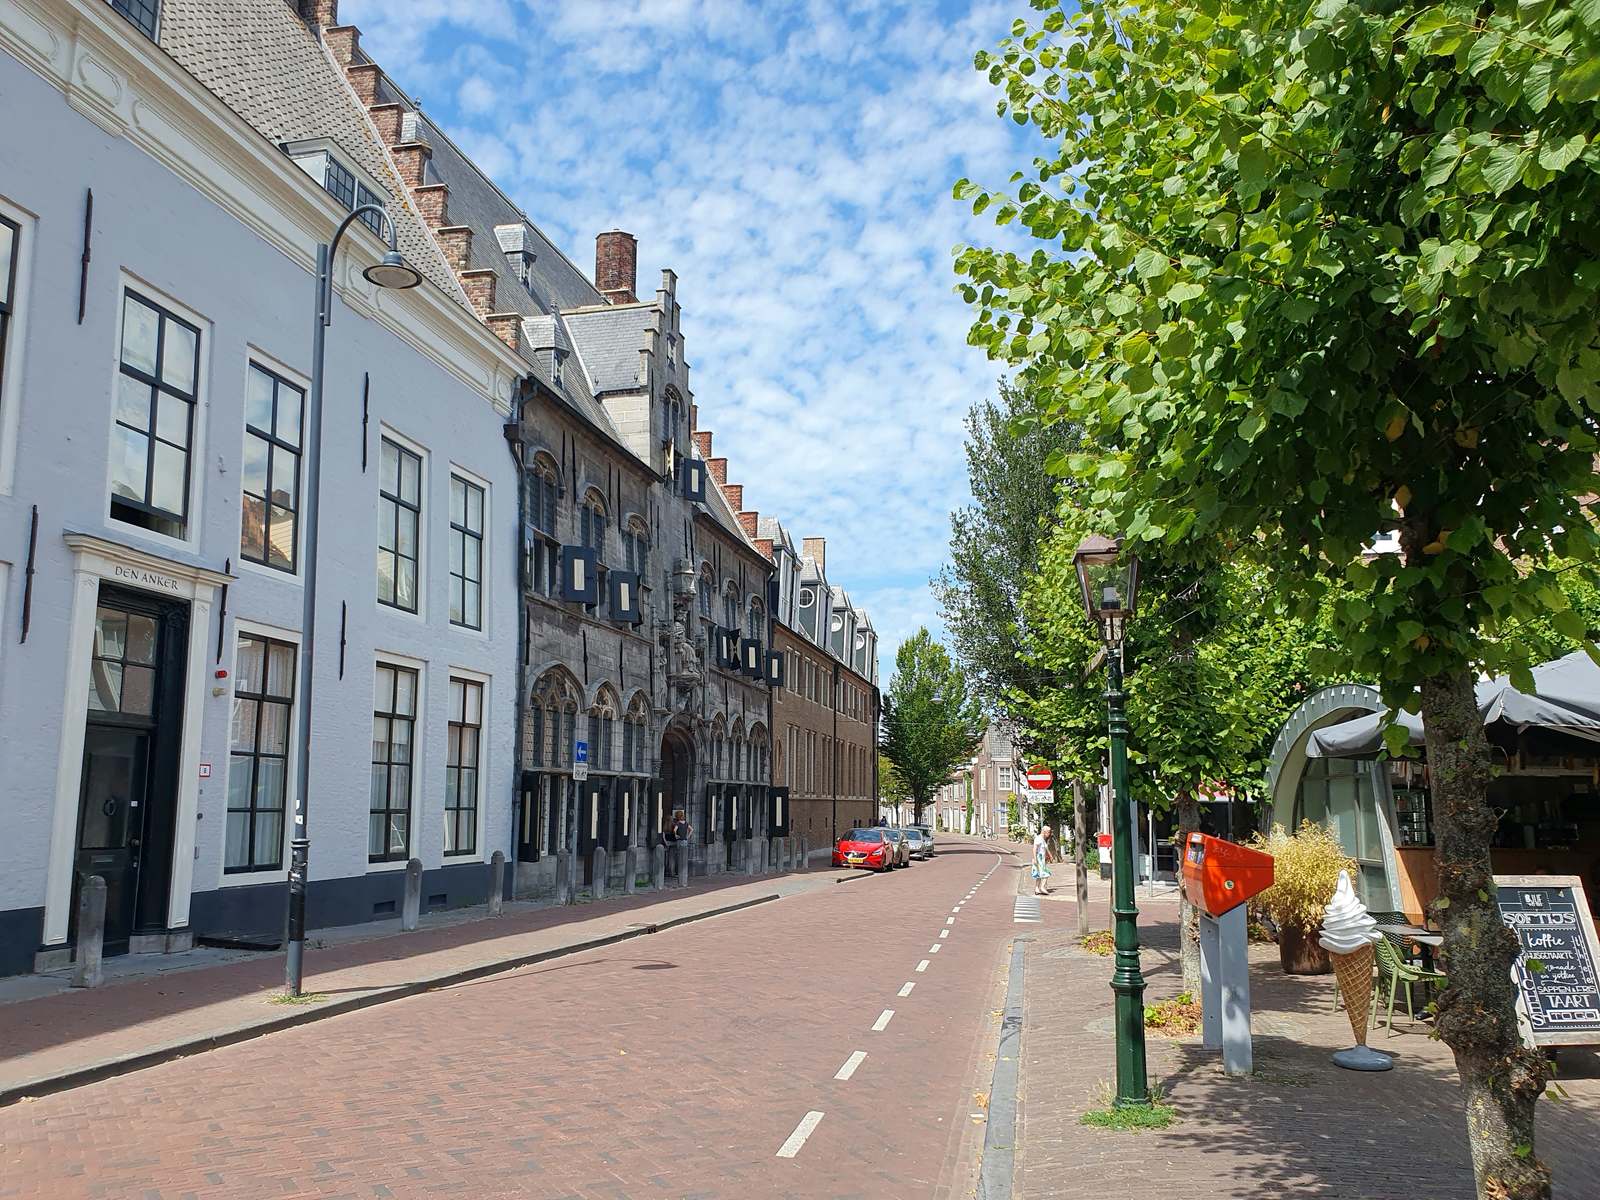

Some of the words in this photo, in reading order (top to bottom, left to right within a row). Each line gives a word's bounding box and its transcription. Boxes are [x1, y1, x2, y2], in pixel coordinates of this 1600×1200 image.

[114, 566, 140, 580] DEN
[141, 573, 179, 591] ANKER
[1503, 912, 1576, 925] SOFTIJS
[1527, 932, 1565, 948] koffie
[1537, 985, 1571, 993] SAPPEN
[1546, 995, 1591, 1008] TAART
[1550, 1012, 1572, 1020] TO
[1573, 1012, 1596, 1020] GO
